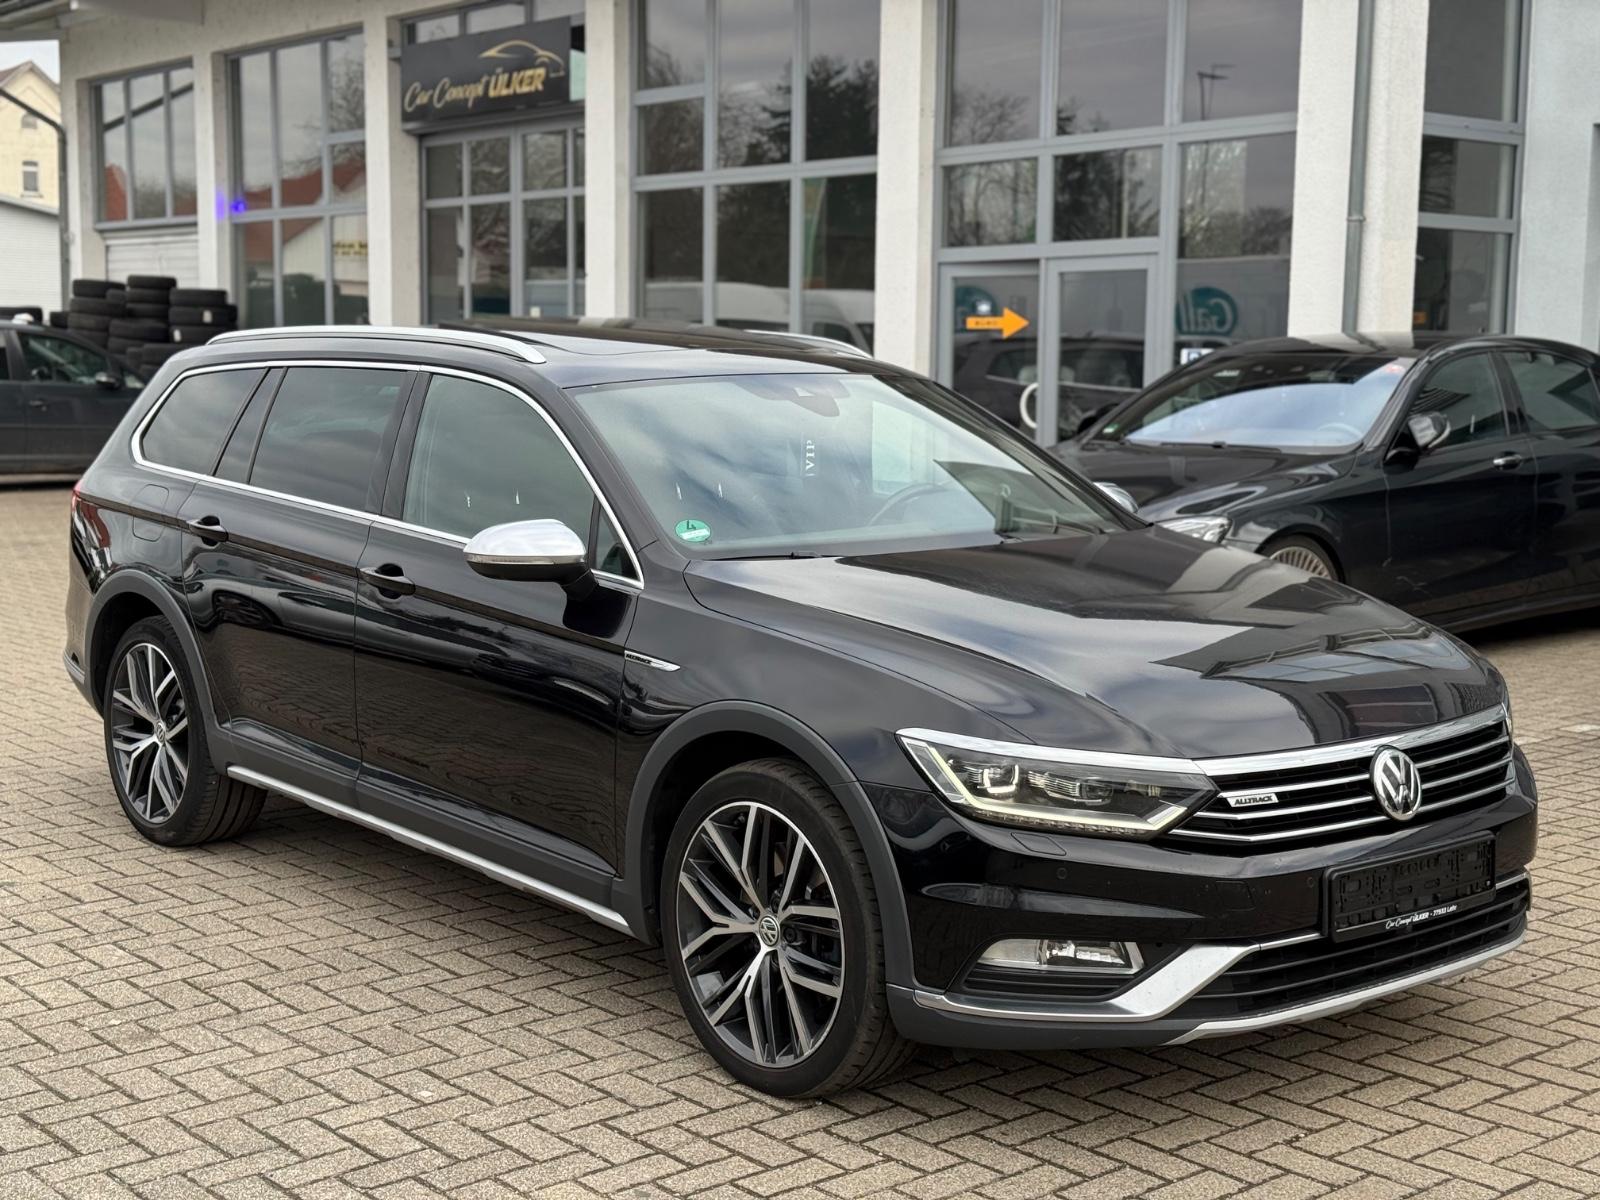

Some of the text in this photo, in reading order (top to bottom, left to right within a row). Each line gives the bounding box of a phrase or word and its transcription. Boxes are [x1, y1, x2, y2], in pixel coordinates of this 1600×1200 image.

[404, 67, 547, 112] Car Concept ÜLKER
[686, 520, 696, 529] 4
[1235, 795, 1273, 805] ALLTRACK
